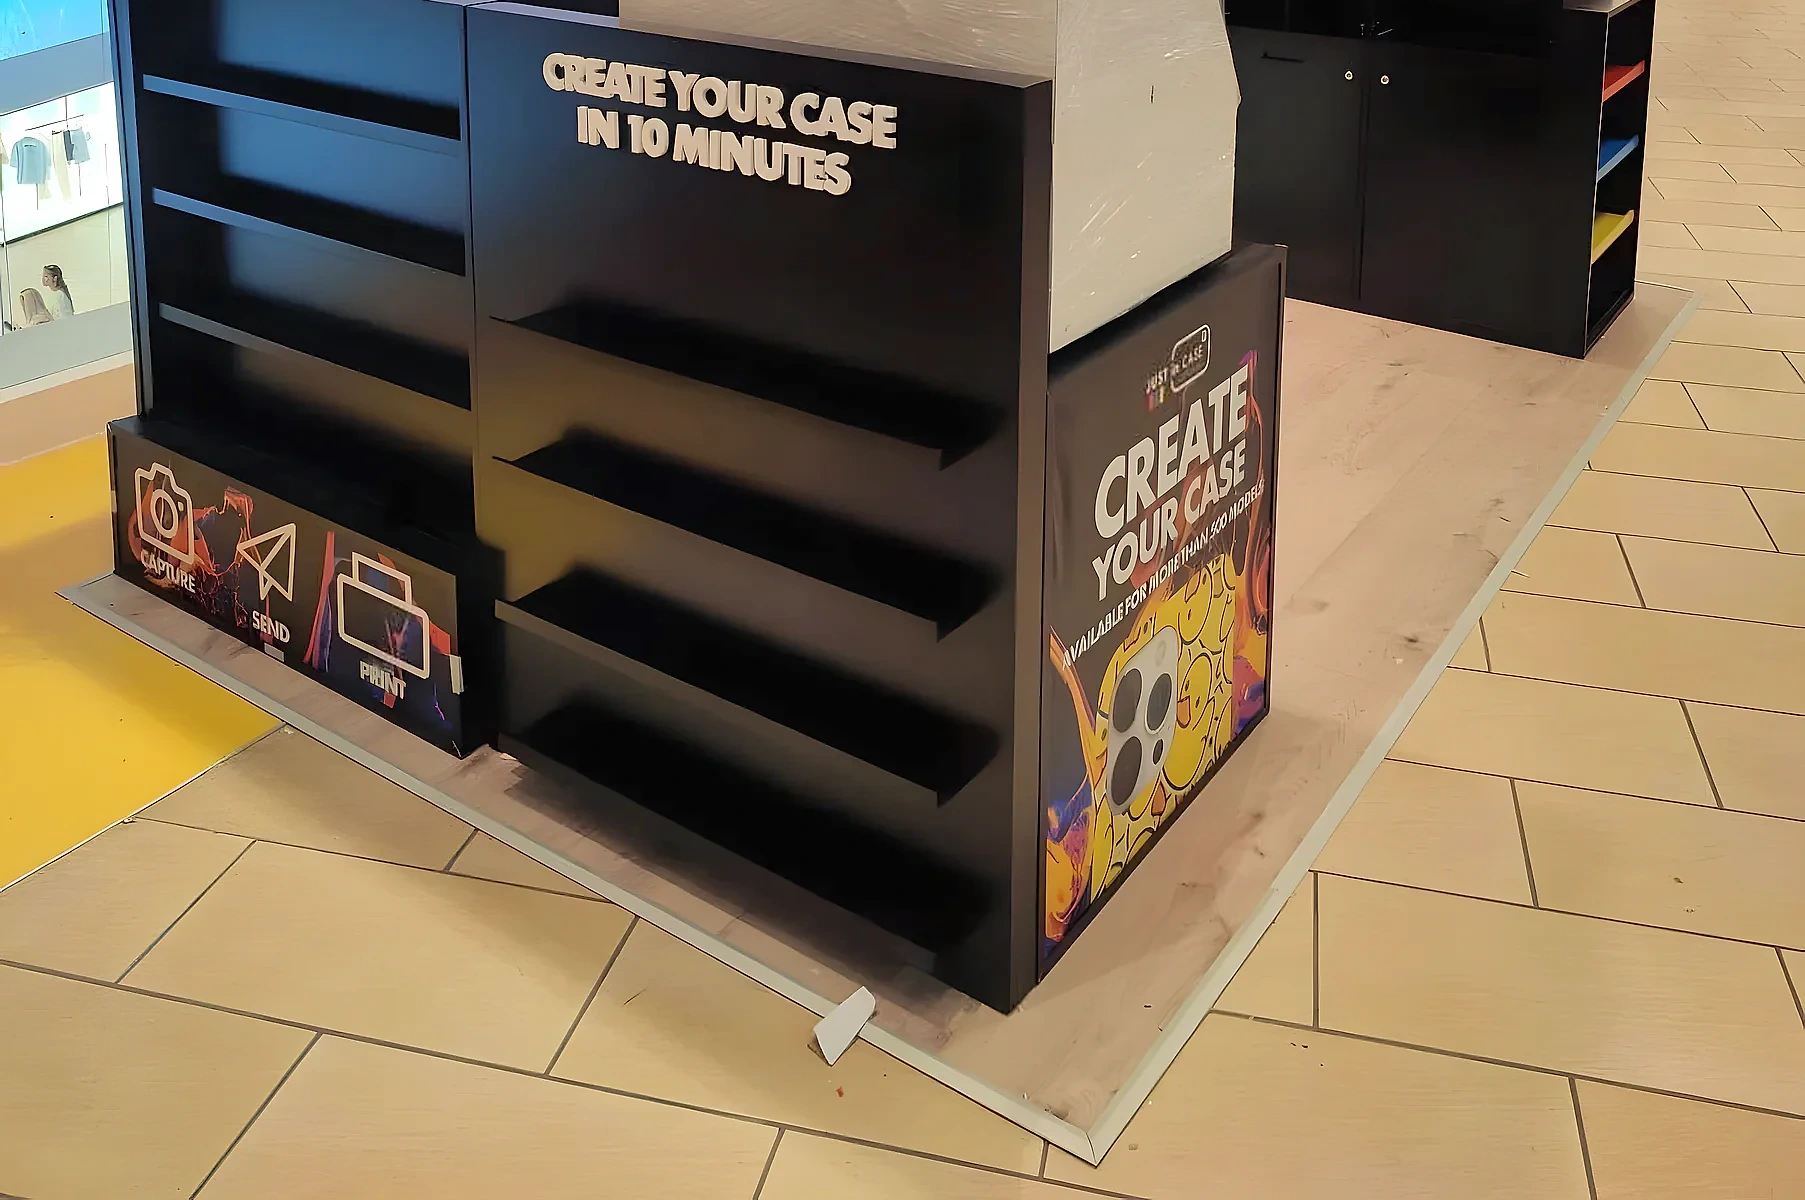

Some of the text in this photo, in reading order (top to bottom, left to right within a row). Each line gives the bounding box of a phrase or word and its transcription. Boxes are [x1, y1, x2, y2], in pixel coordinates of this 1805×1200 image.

[542, 52, 898, 149] CREATE YOUR CASE
[577, 106, 852, 195] IN 10 MINUTES
[1094, 363, 1249, 539] CREATE
[1092, 438, 1246, 602] YOUR CASE
[140, 549, 196, 594] CAPTURE
[1062, 605, 1125, 671] AVAILABLE
[1124, 581, 1148, 613] FOR
[1148, 556, 1180, 595] MORE
[1180, 531, 1210, 566] THAN
[252, 609, 290, 644] SEND
[360, 660, 407, 699] PRINT
